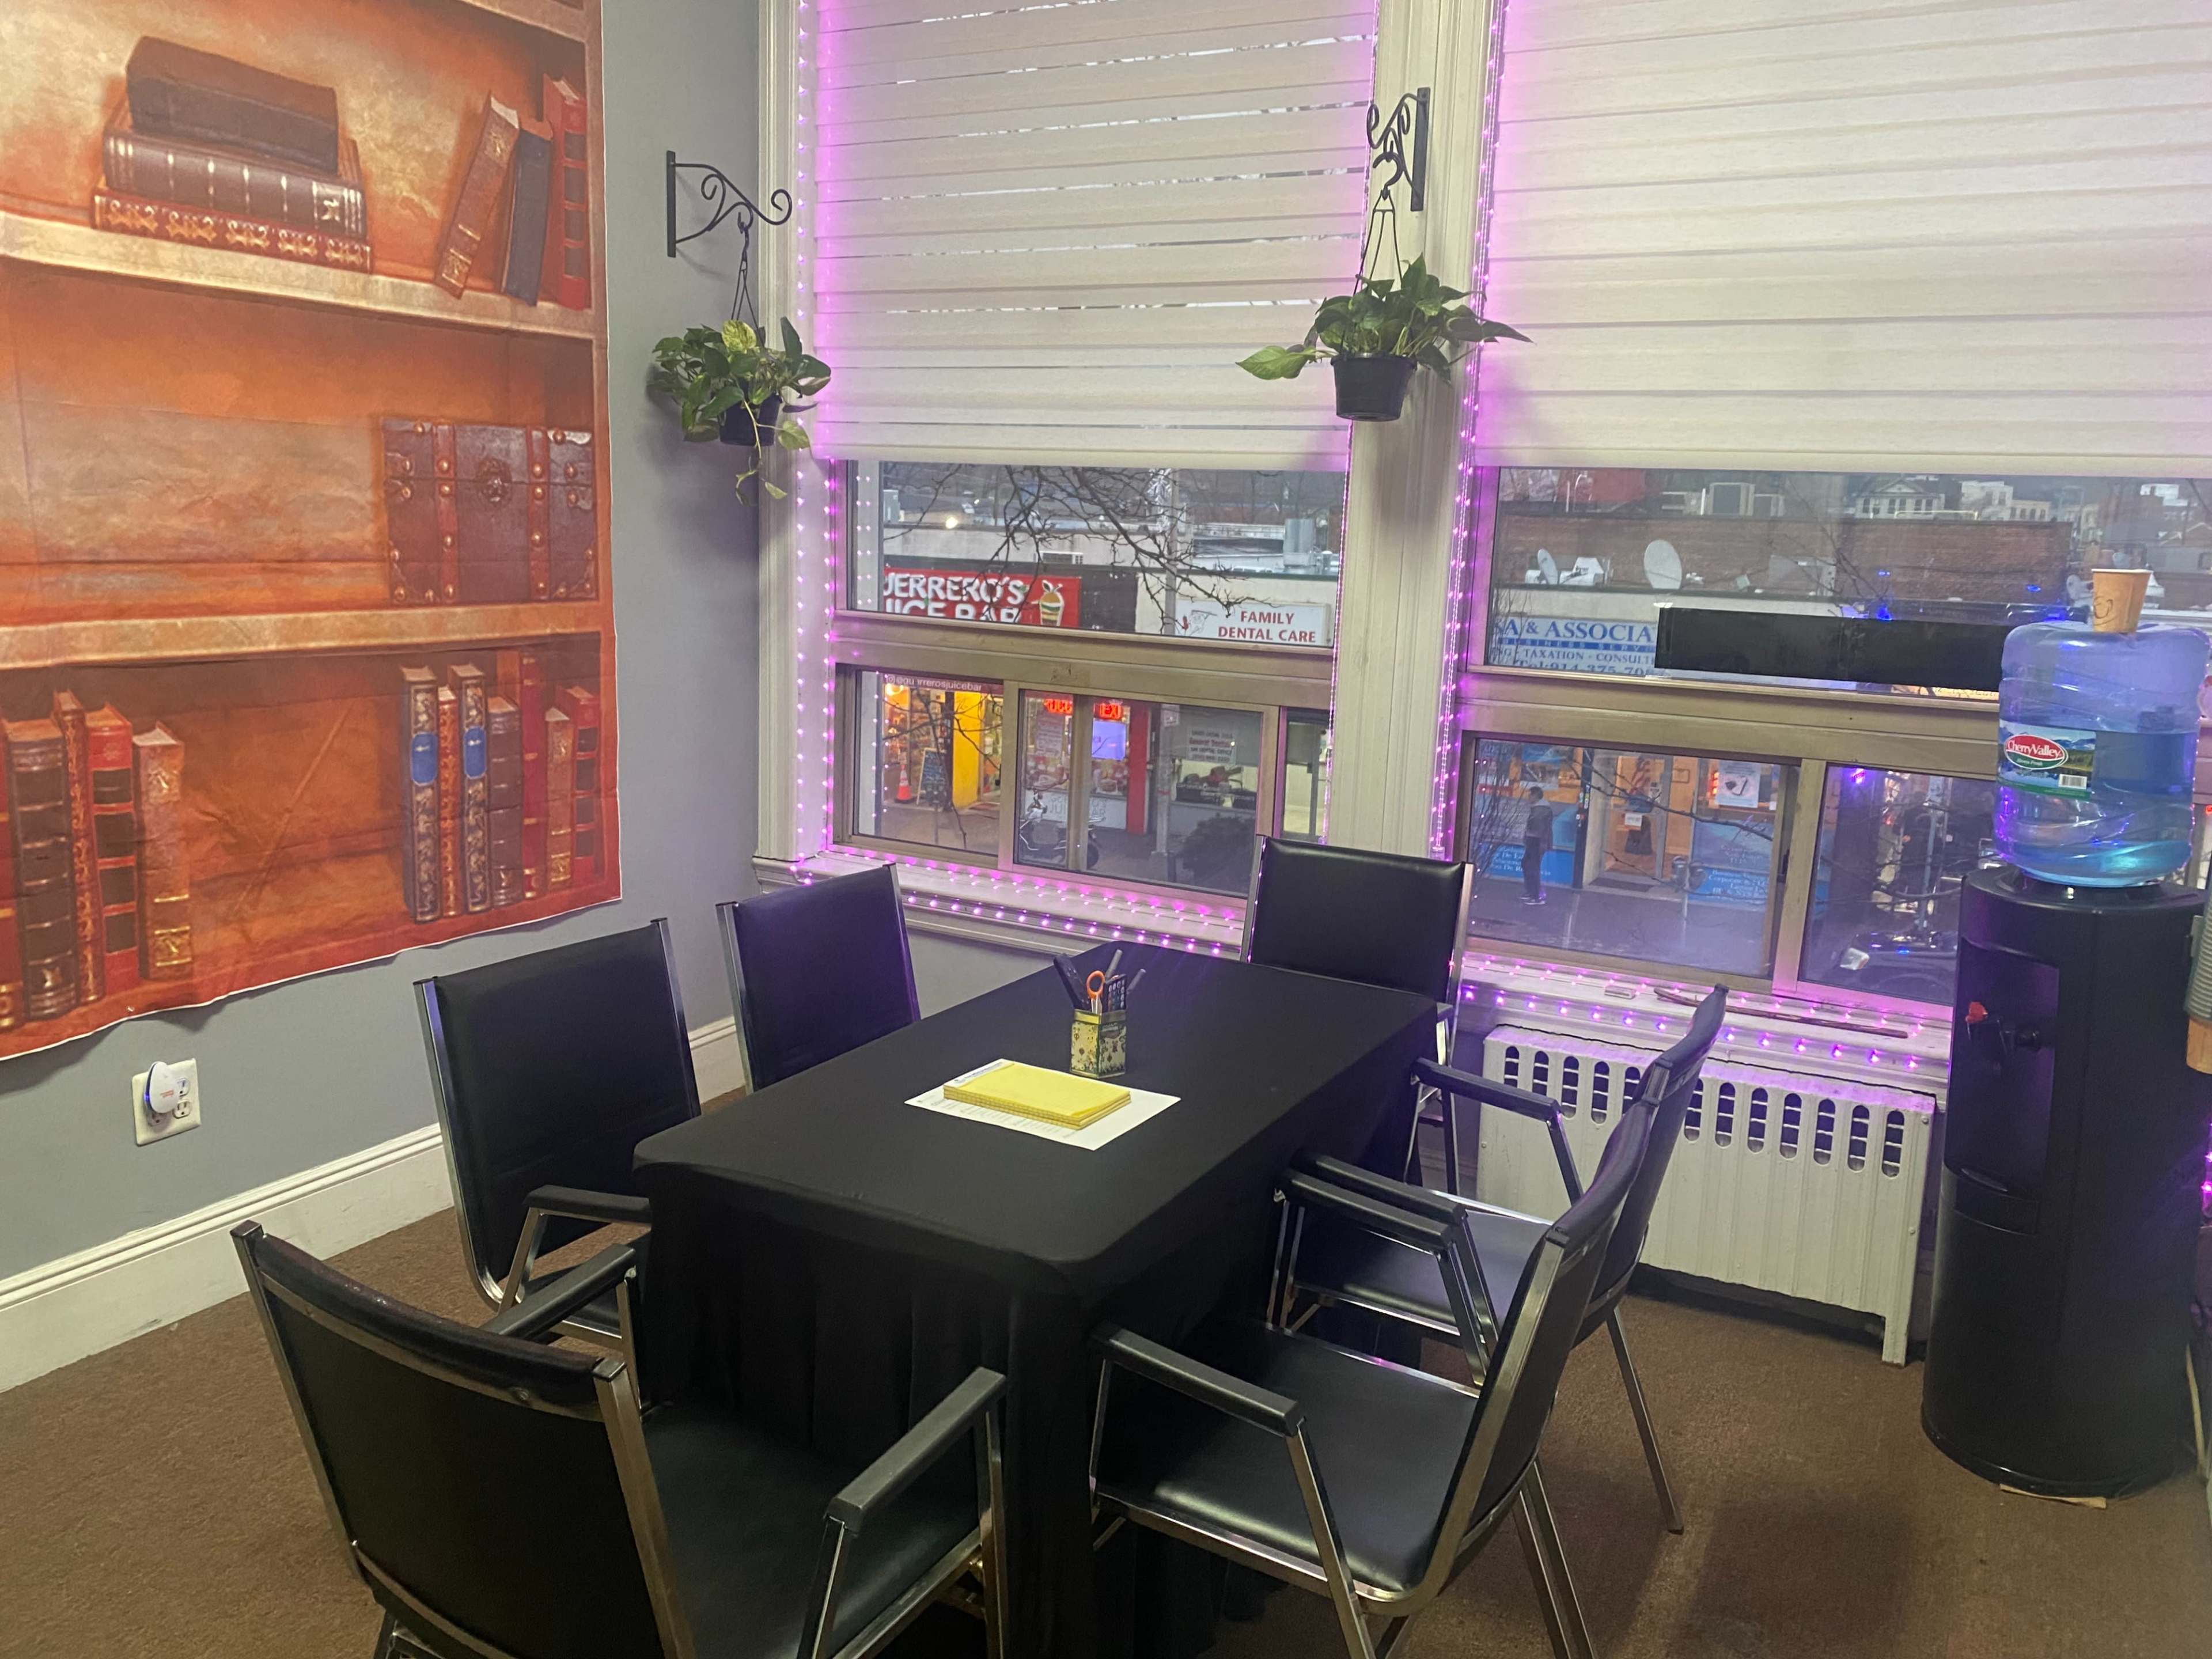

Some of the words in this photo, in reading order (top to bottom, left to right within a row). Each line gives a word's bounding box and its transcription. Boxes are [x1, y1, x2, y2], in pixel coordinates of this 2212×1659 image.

[1240, 611, 1294, 625] FAMILY
[1218, 626, 1273, 641] DENTAL
[1279, 630, 1316, 643] CARE
[1525, 622, 1539, 635] &
[1544, 620, 1655, 643] ASSOCIA
[1524, 649, 1584, 660] TAXATION
